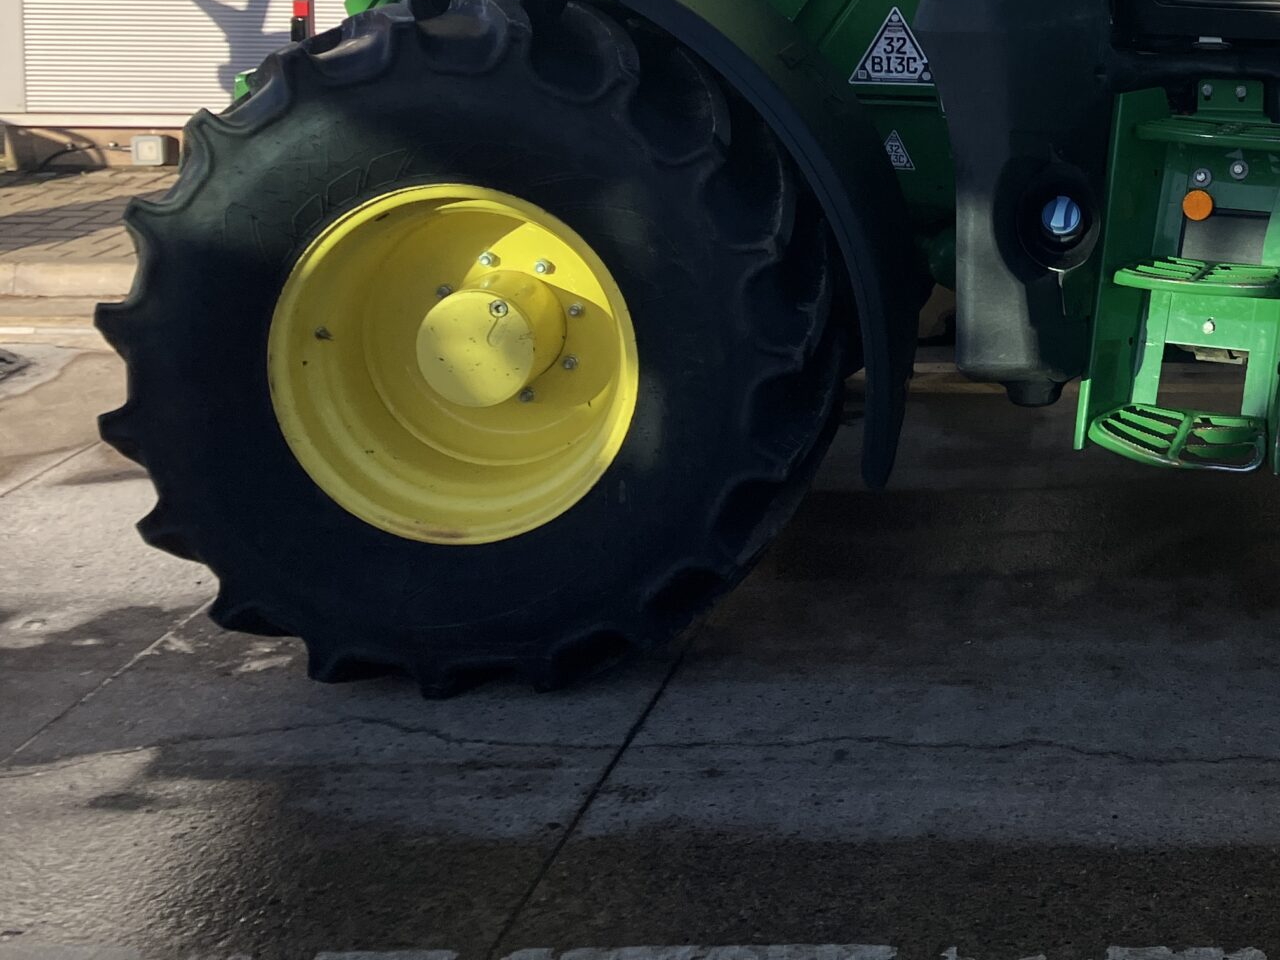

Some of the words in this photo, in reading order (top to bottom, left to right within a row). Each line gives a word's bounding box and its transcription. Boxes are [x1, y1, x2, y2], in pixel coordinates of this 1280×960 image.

[883, 36, 907, 55] 32
[888, 144, 900, 153] 32
[892, 154, 905, 164] 3C
